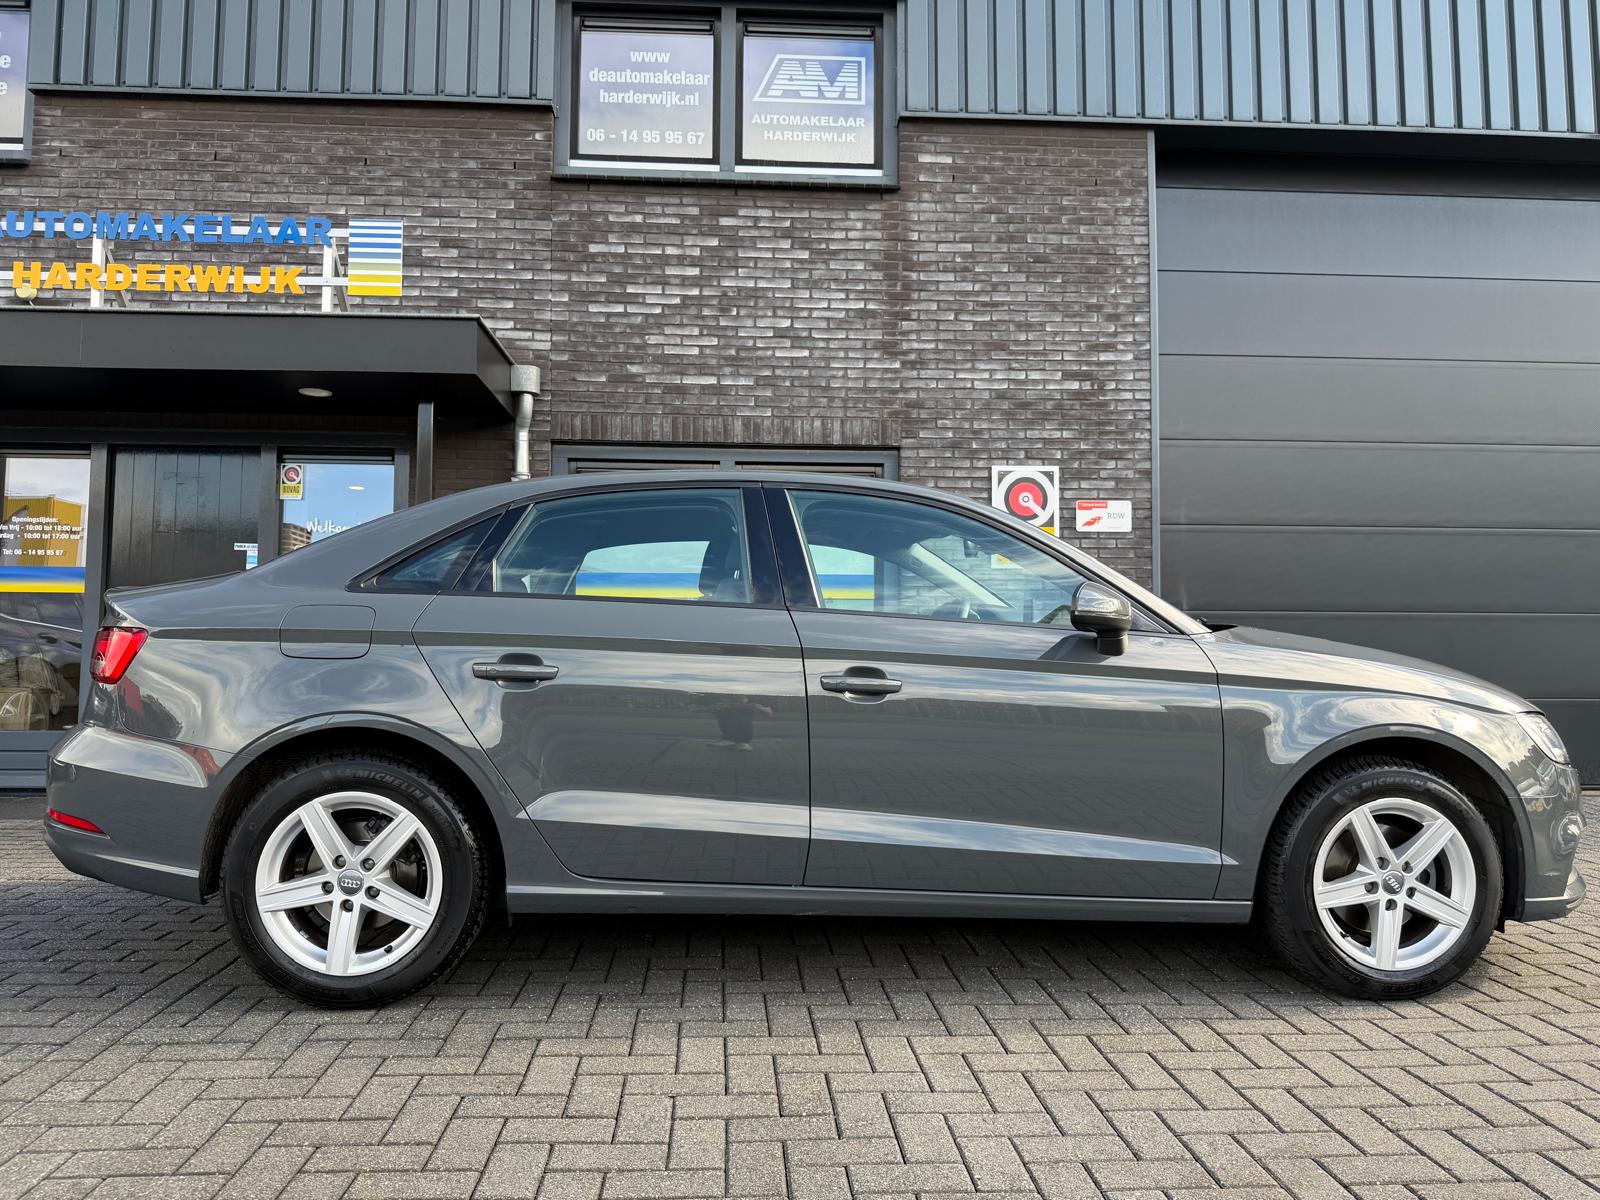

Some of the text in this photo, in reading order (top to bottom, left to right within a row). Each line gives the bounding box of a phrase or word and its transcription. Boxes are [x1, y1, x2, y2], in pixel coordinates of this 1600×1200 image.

[630, 51, 670, 63] www
[589, 67, 711, 86] deautomakelaar
[767, 60, 858, 99] AM
[599, 89, 699, 107] harderwijk.nl
[752, 113, 865, 127] AUTOMAKELAAR
[586, 128, 605, 142] 06
[620, 129, 639, 143] 14
[642, 130, 661, 143] 95
[664, 131, 682, 144] 95
[687, 131, 705, 145] 67
[764, 130, 856, 143] HARDERWIJK
[12, 261, 305, 295] HARDERWIJK
[357, 770, 425, 799] MICHELIN
[1362, 776, 1425, 789] MICHELIN
